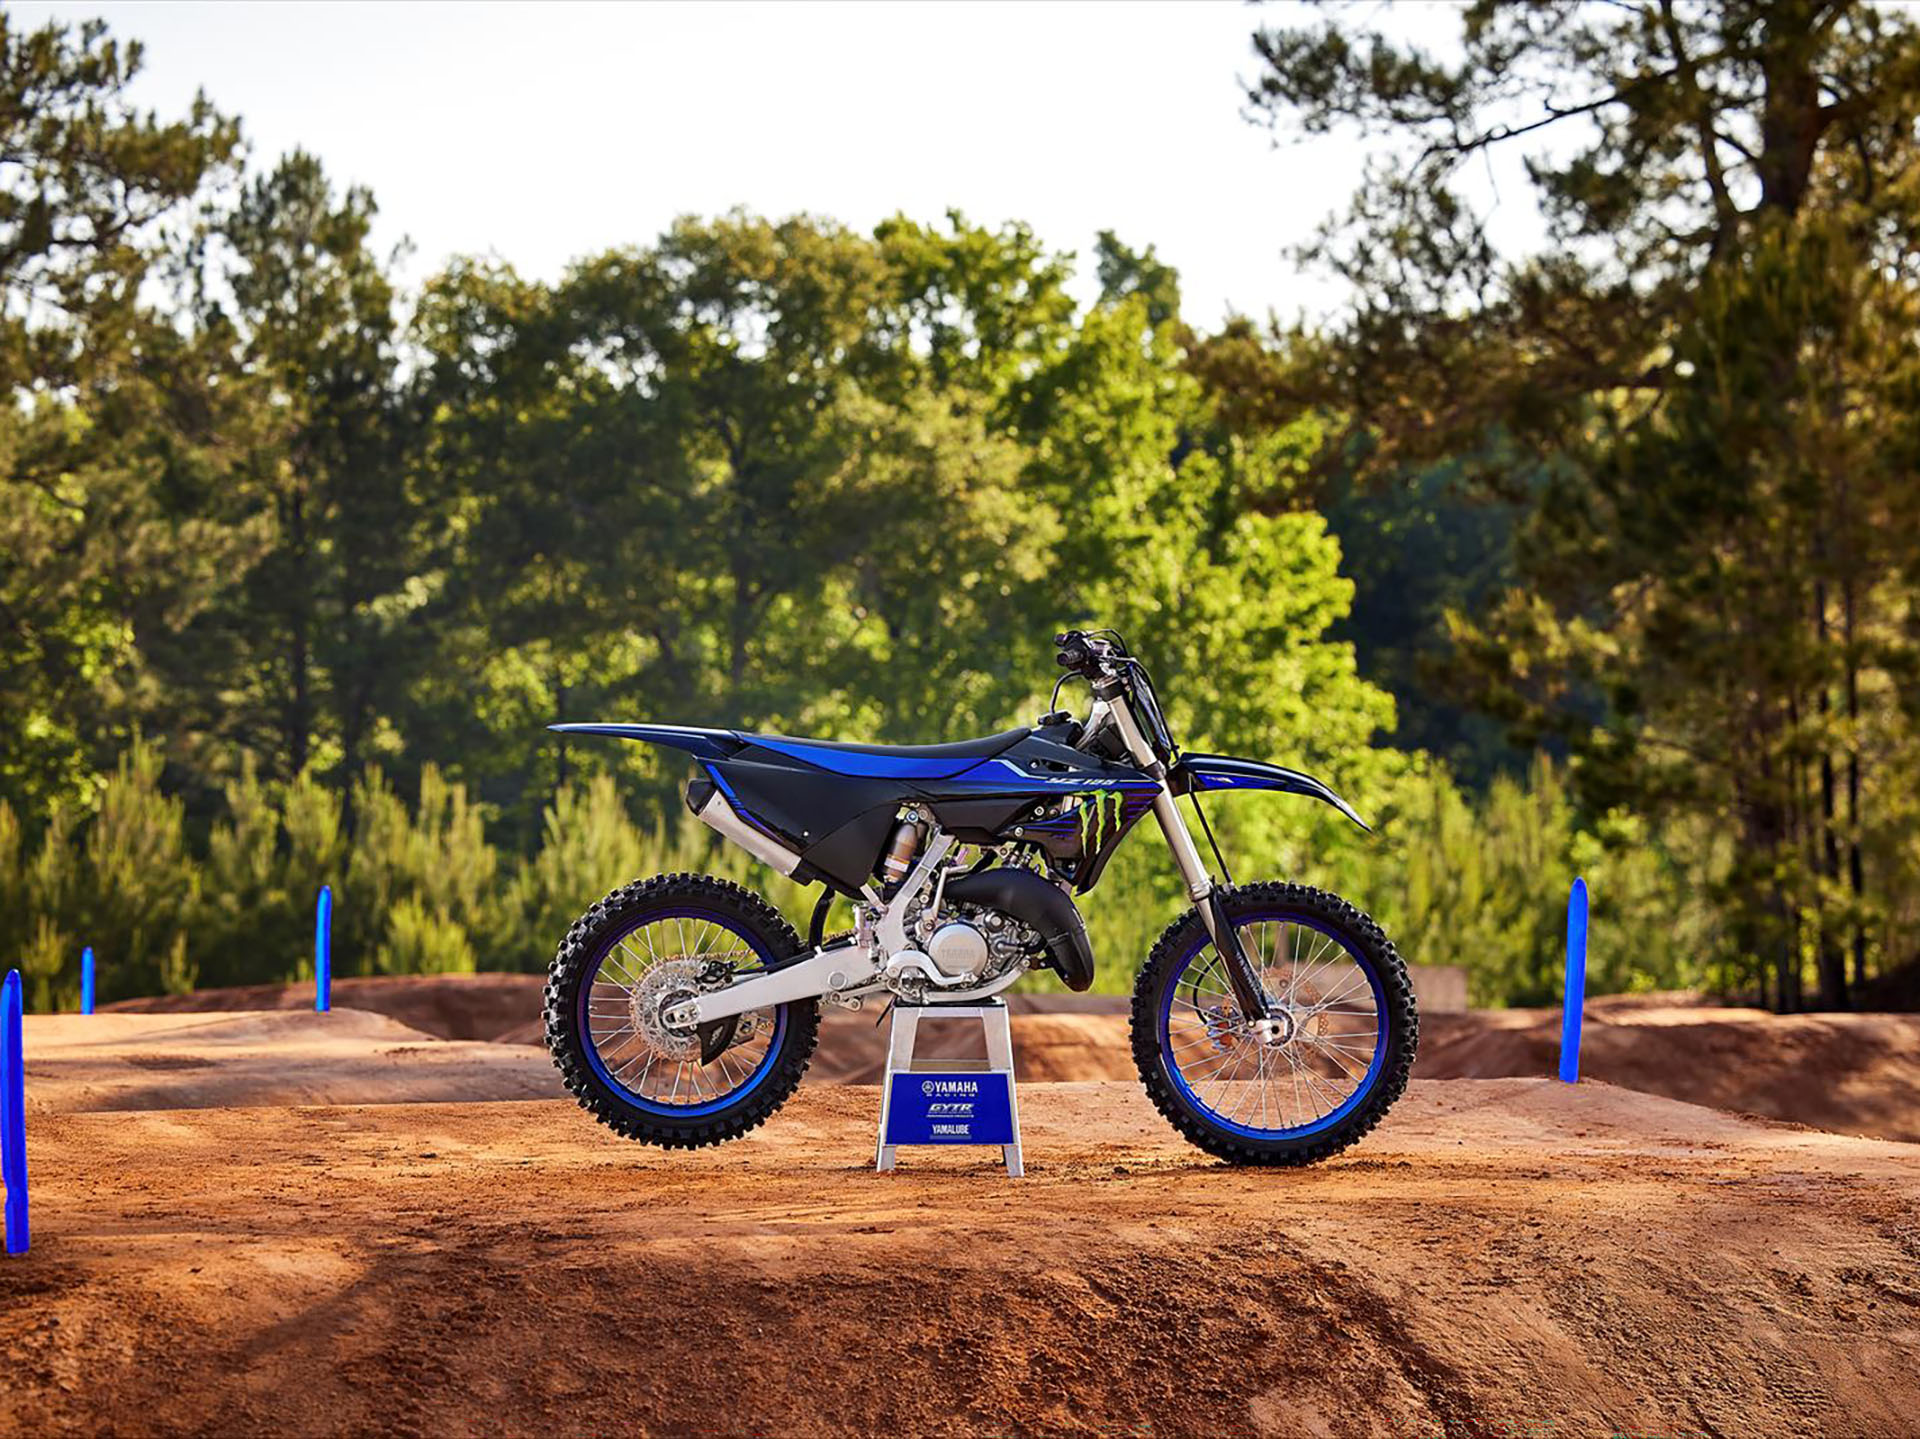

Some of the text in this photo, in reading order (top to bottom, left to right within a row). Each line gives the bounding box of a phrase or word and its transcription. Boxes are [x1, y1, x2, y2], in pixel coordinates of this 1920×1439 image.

[935, 1081, 978, 1093] YAMAHA
[929, 1103, 975, 1112] GYTR
[931, 1124, 970, 1134] YAMALUBE
